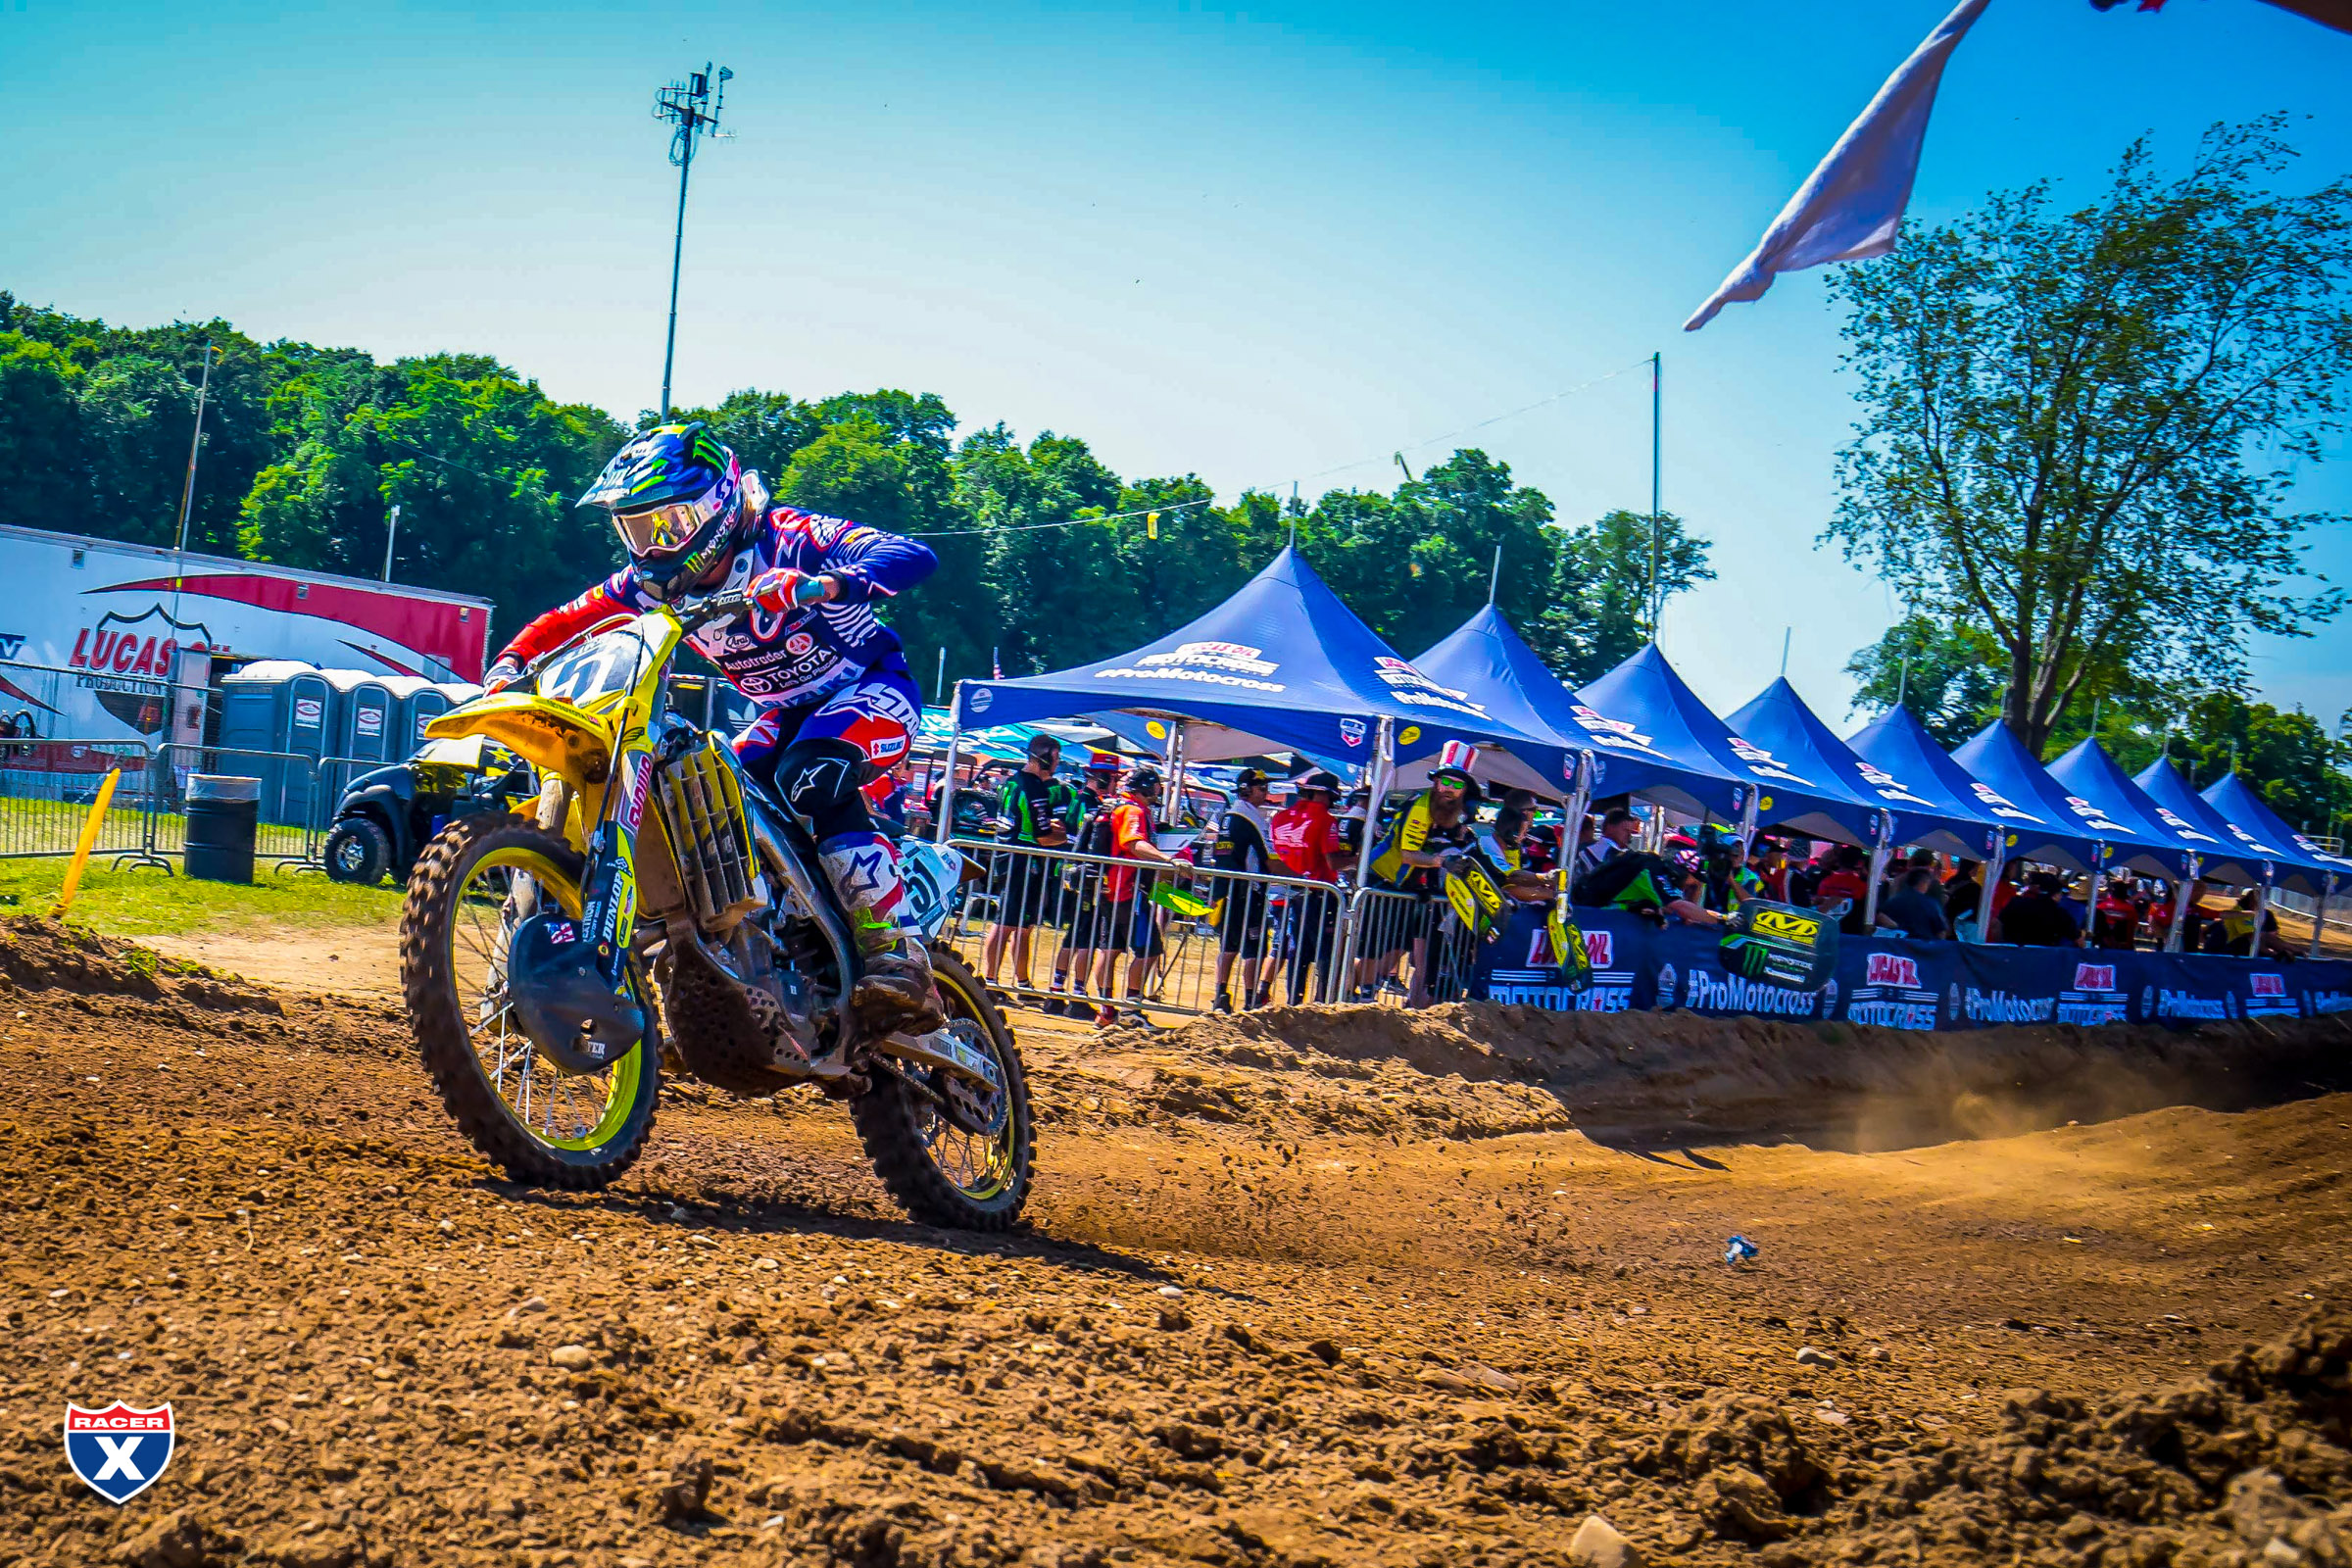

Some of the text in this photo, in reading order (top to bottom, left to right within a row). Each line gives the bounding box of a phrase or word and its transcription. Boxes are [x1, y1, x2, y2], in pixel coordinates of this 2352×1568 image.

[69, 628, 177, 676] LUCAS
[724, 647, 788, 671] Autotrader
[766, 648, 832, 680] TOYOTA
[799, 671, 812, 683] Go
[812, 655, 840, 678] Places
[603, 870, 624, 943] DUNLOP
[1686, 969, 1817, 1016] #ProMotocross
